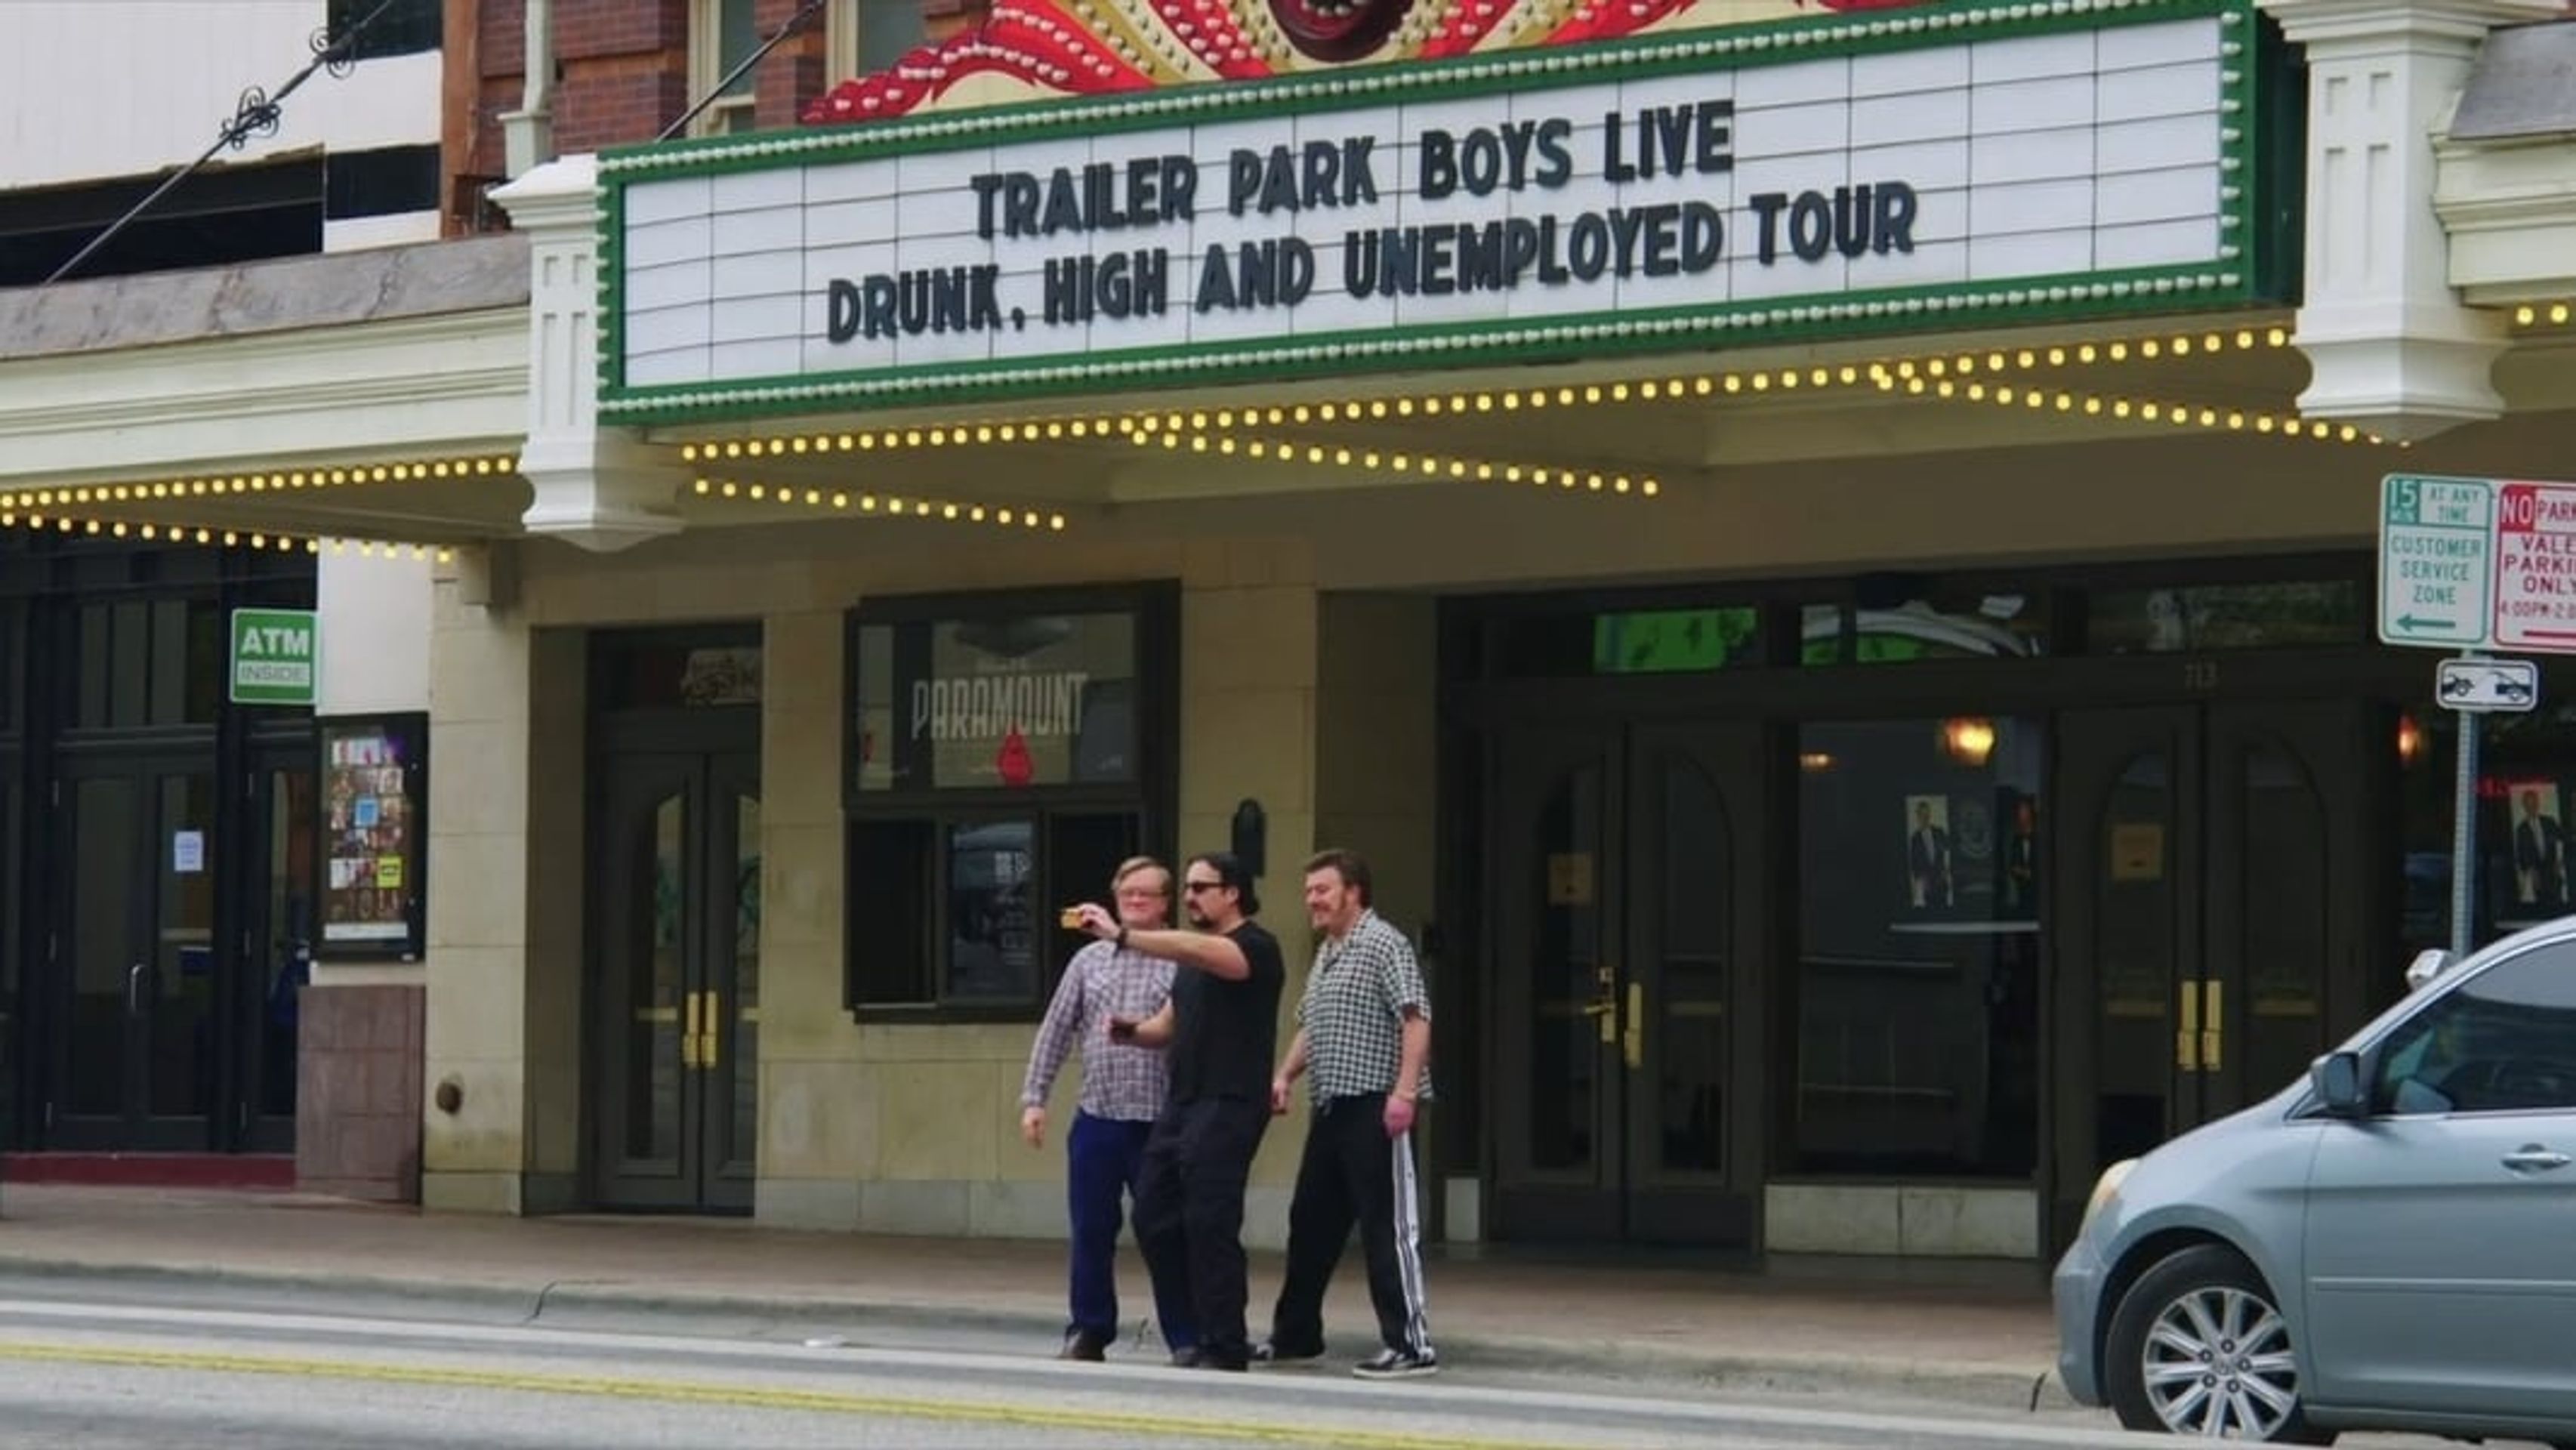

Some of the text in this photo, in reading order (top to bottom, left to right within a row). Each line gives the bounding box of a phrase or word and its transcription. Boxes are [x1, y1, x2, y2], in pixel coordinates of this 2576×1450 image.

[970, 98, 1735, 239] TRAILER PARK BOYS LIVE
[1043, 247, 1168, 323] HIGH
[1195, 236, 1316, 313] AND
[1344, 200, 1724, 299] UNEMPLOYED
[1750, 180, 1919, 265] TOUR
[2390, 480, 2417, 508] 15
[2429, 487, 2479, 501] AT ANY
[2438, 505, 2470, 523] TIME
[2500, 494, 2533, 523] NO
[2391, 536, 2482, 557] CUSTOMER
[2400, 560, 2470, 582] SERVICE
[2504, 555, 2576, 573] PARKI
[2413, 585, 2455, 605] ZONE
[241, 627, 309, 656] ATM
[241, 665, 307, 681] INSIDE
[911, 672, 1089, 740] PARAMOUNT
